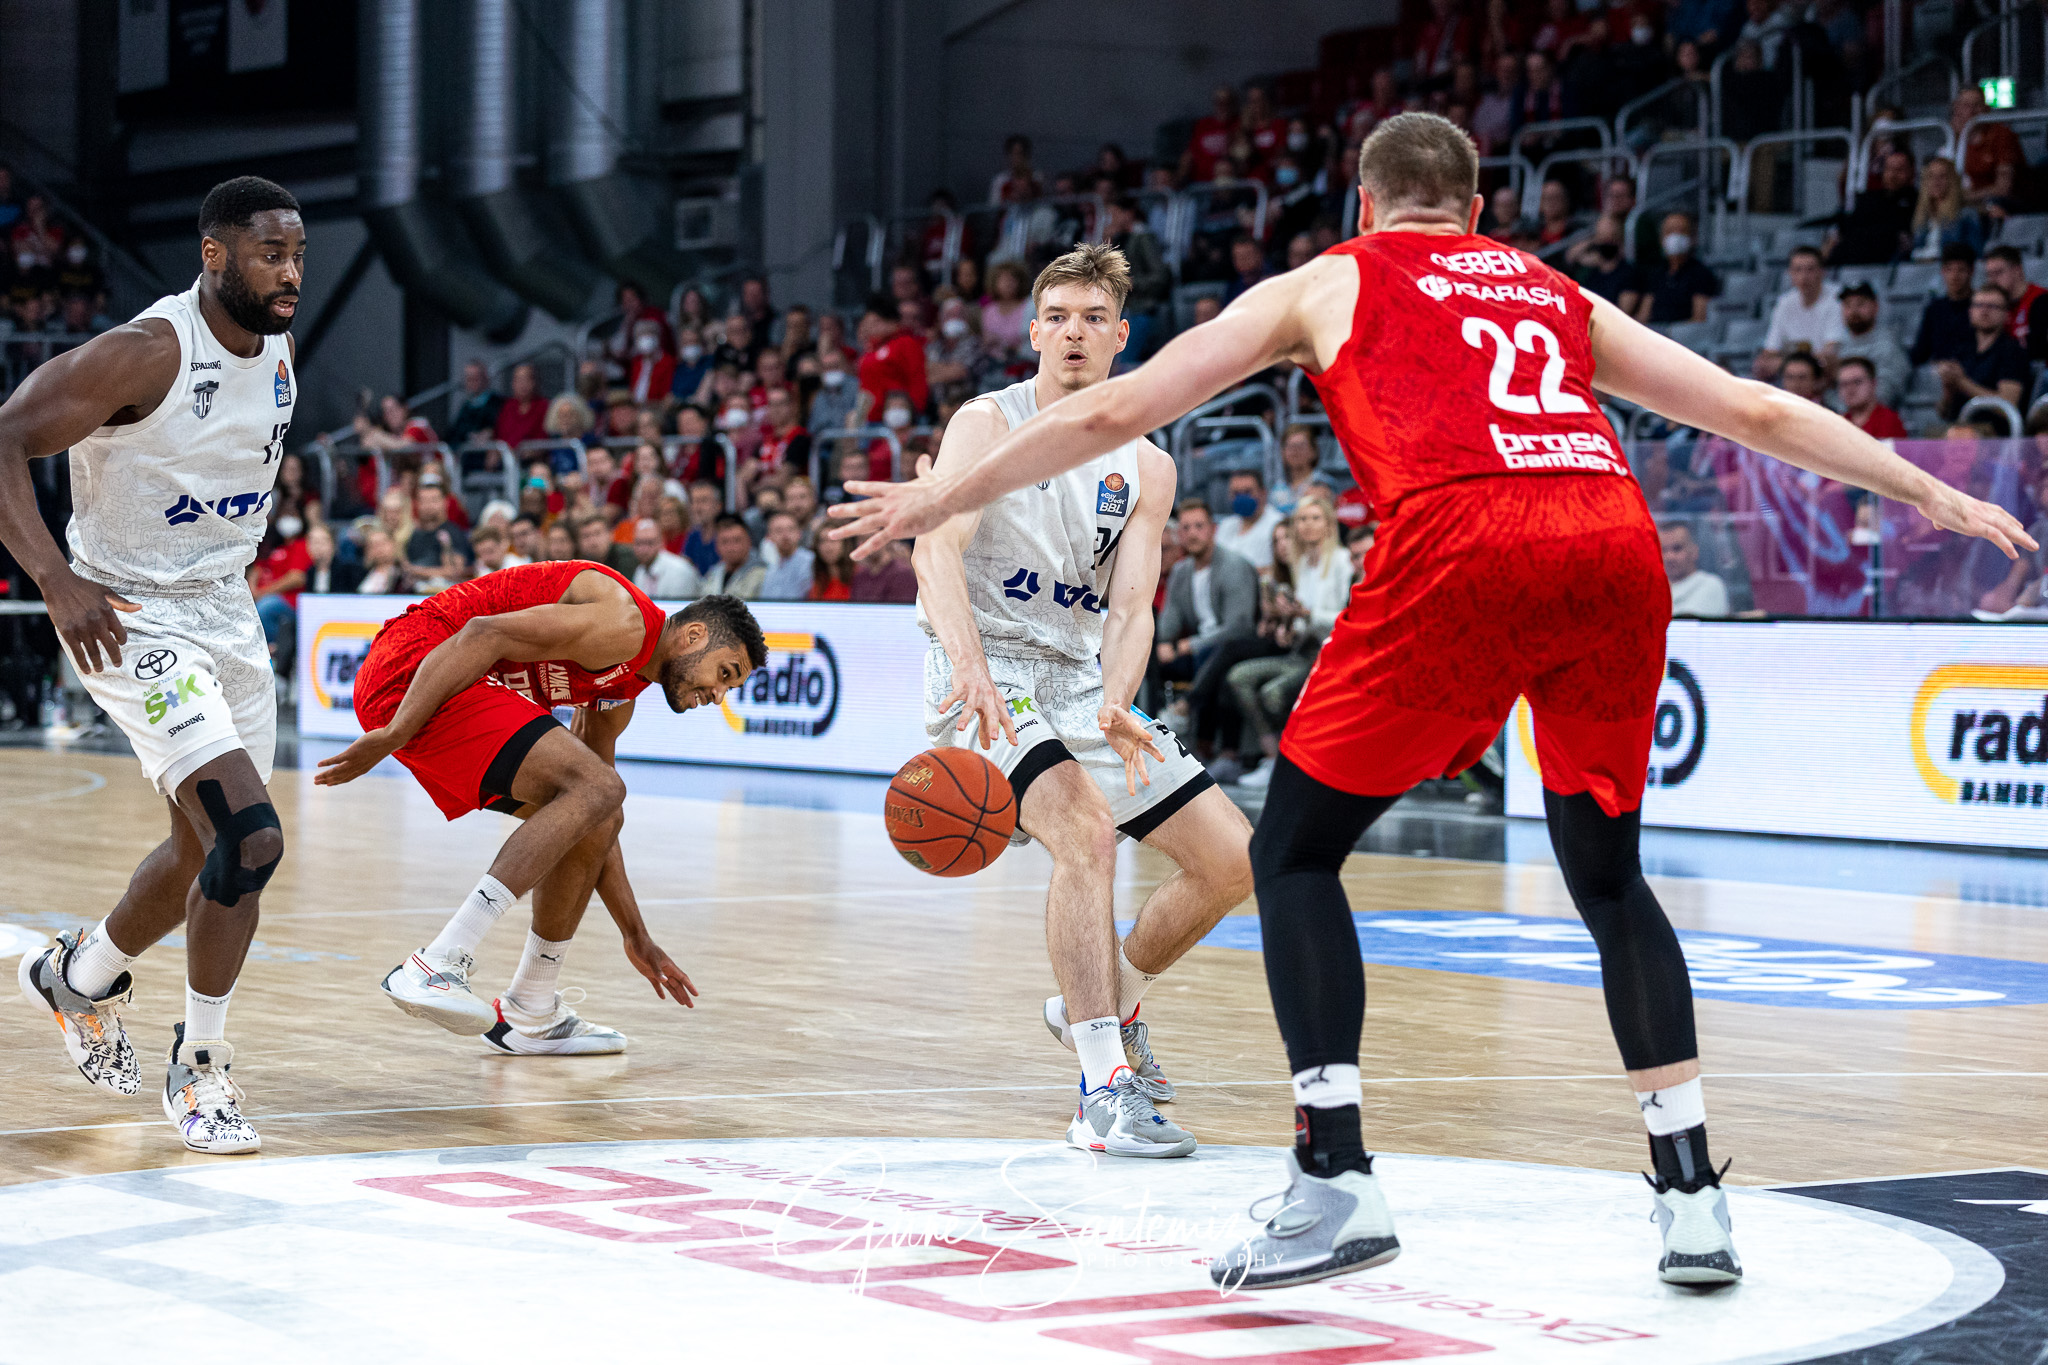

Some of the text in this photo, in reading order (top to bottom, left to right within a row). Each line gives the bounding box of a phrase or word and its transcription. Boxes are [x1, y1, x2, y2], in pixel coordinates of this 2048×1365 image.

[1453, 282, 1567, 314] IGARASHI
[190, 361, 221, 371] SPALDING
[1461, 316, 1591, 415] 22
[278, 392, 291, 405] BBL
[1099, 501, 1123, 514] BBL
[737, 656, 824, 706] radio
[145, 673, 206, 725] S+K
[167, 712, 206, 738] SPALDING
